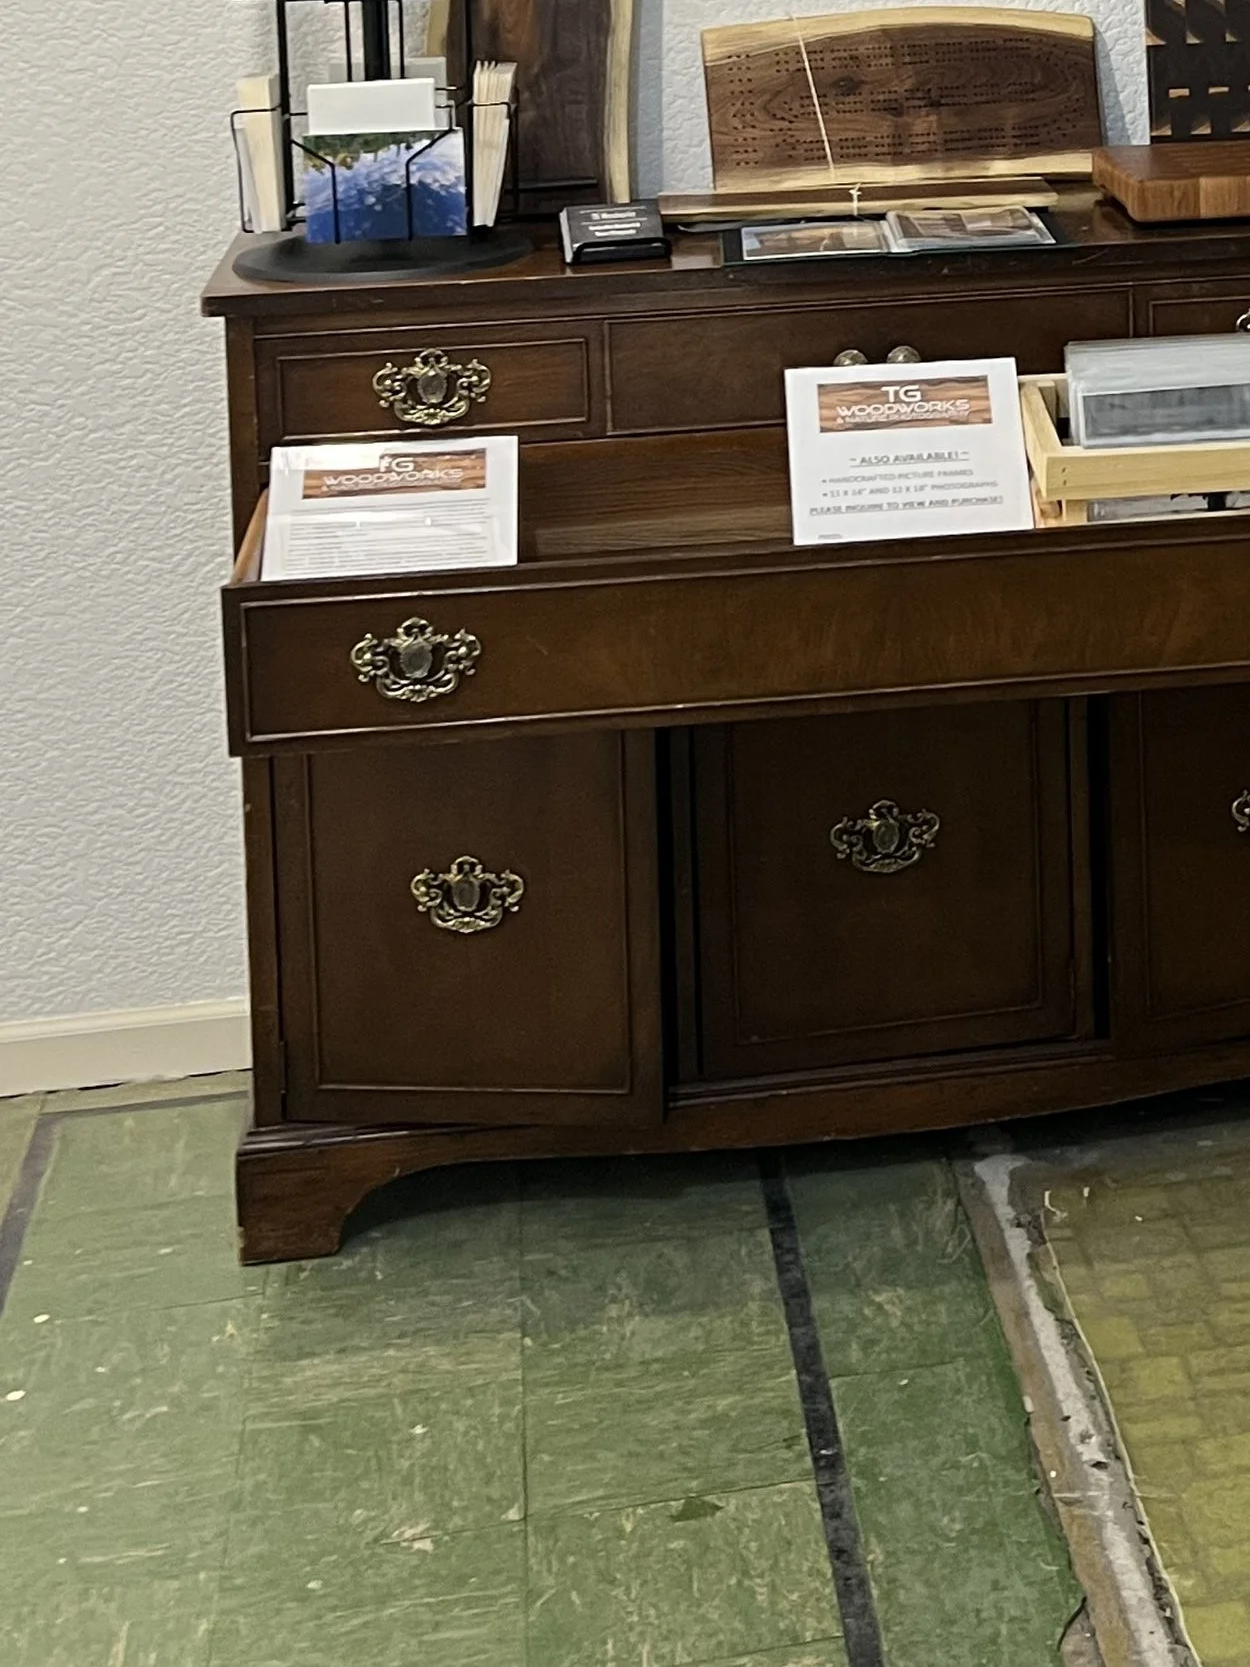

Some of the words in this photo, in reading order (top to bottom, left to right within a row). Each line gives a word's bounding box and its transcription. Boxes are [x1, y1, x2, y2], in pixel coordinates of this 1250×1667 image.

[880, 384, 922, 403] TG
[836, 399, 970, 417] WOODWORKS
[860, 454, 890, 465] ALSO
[893, 451, 960, 463] AVAILABLE!
[322, 468, 464, 485] WOODWORKS
